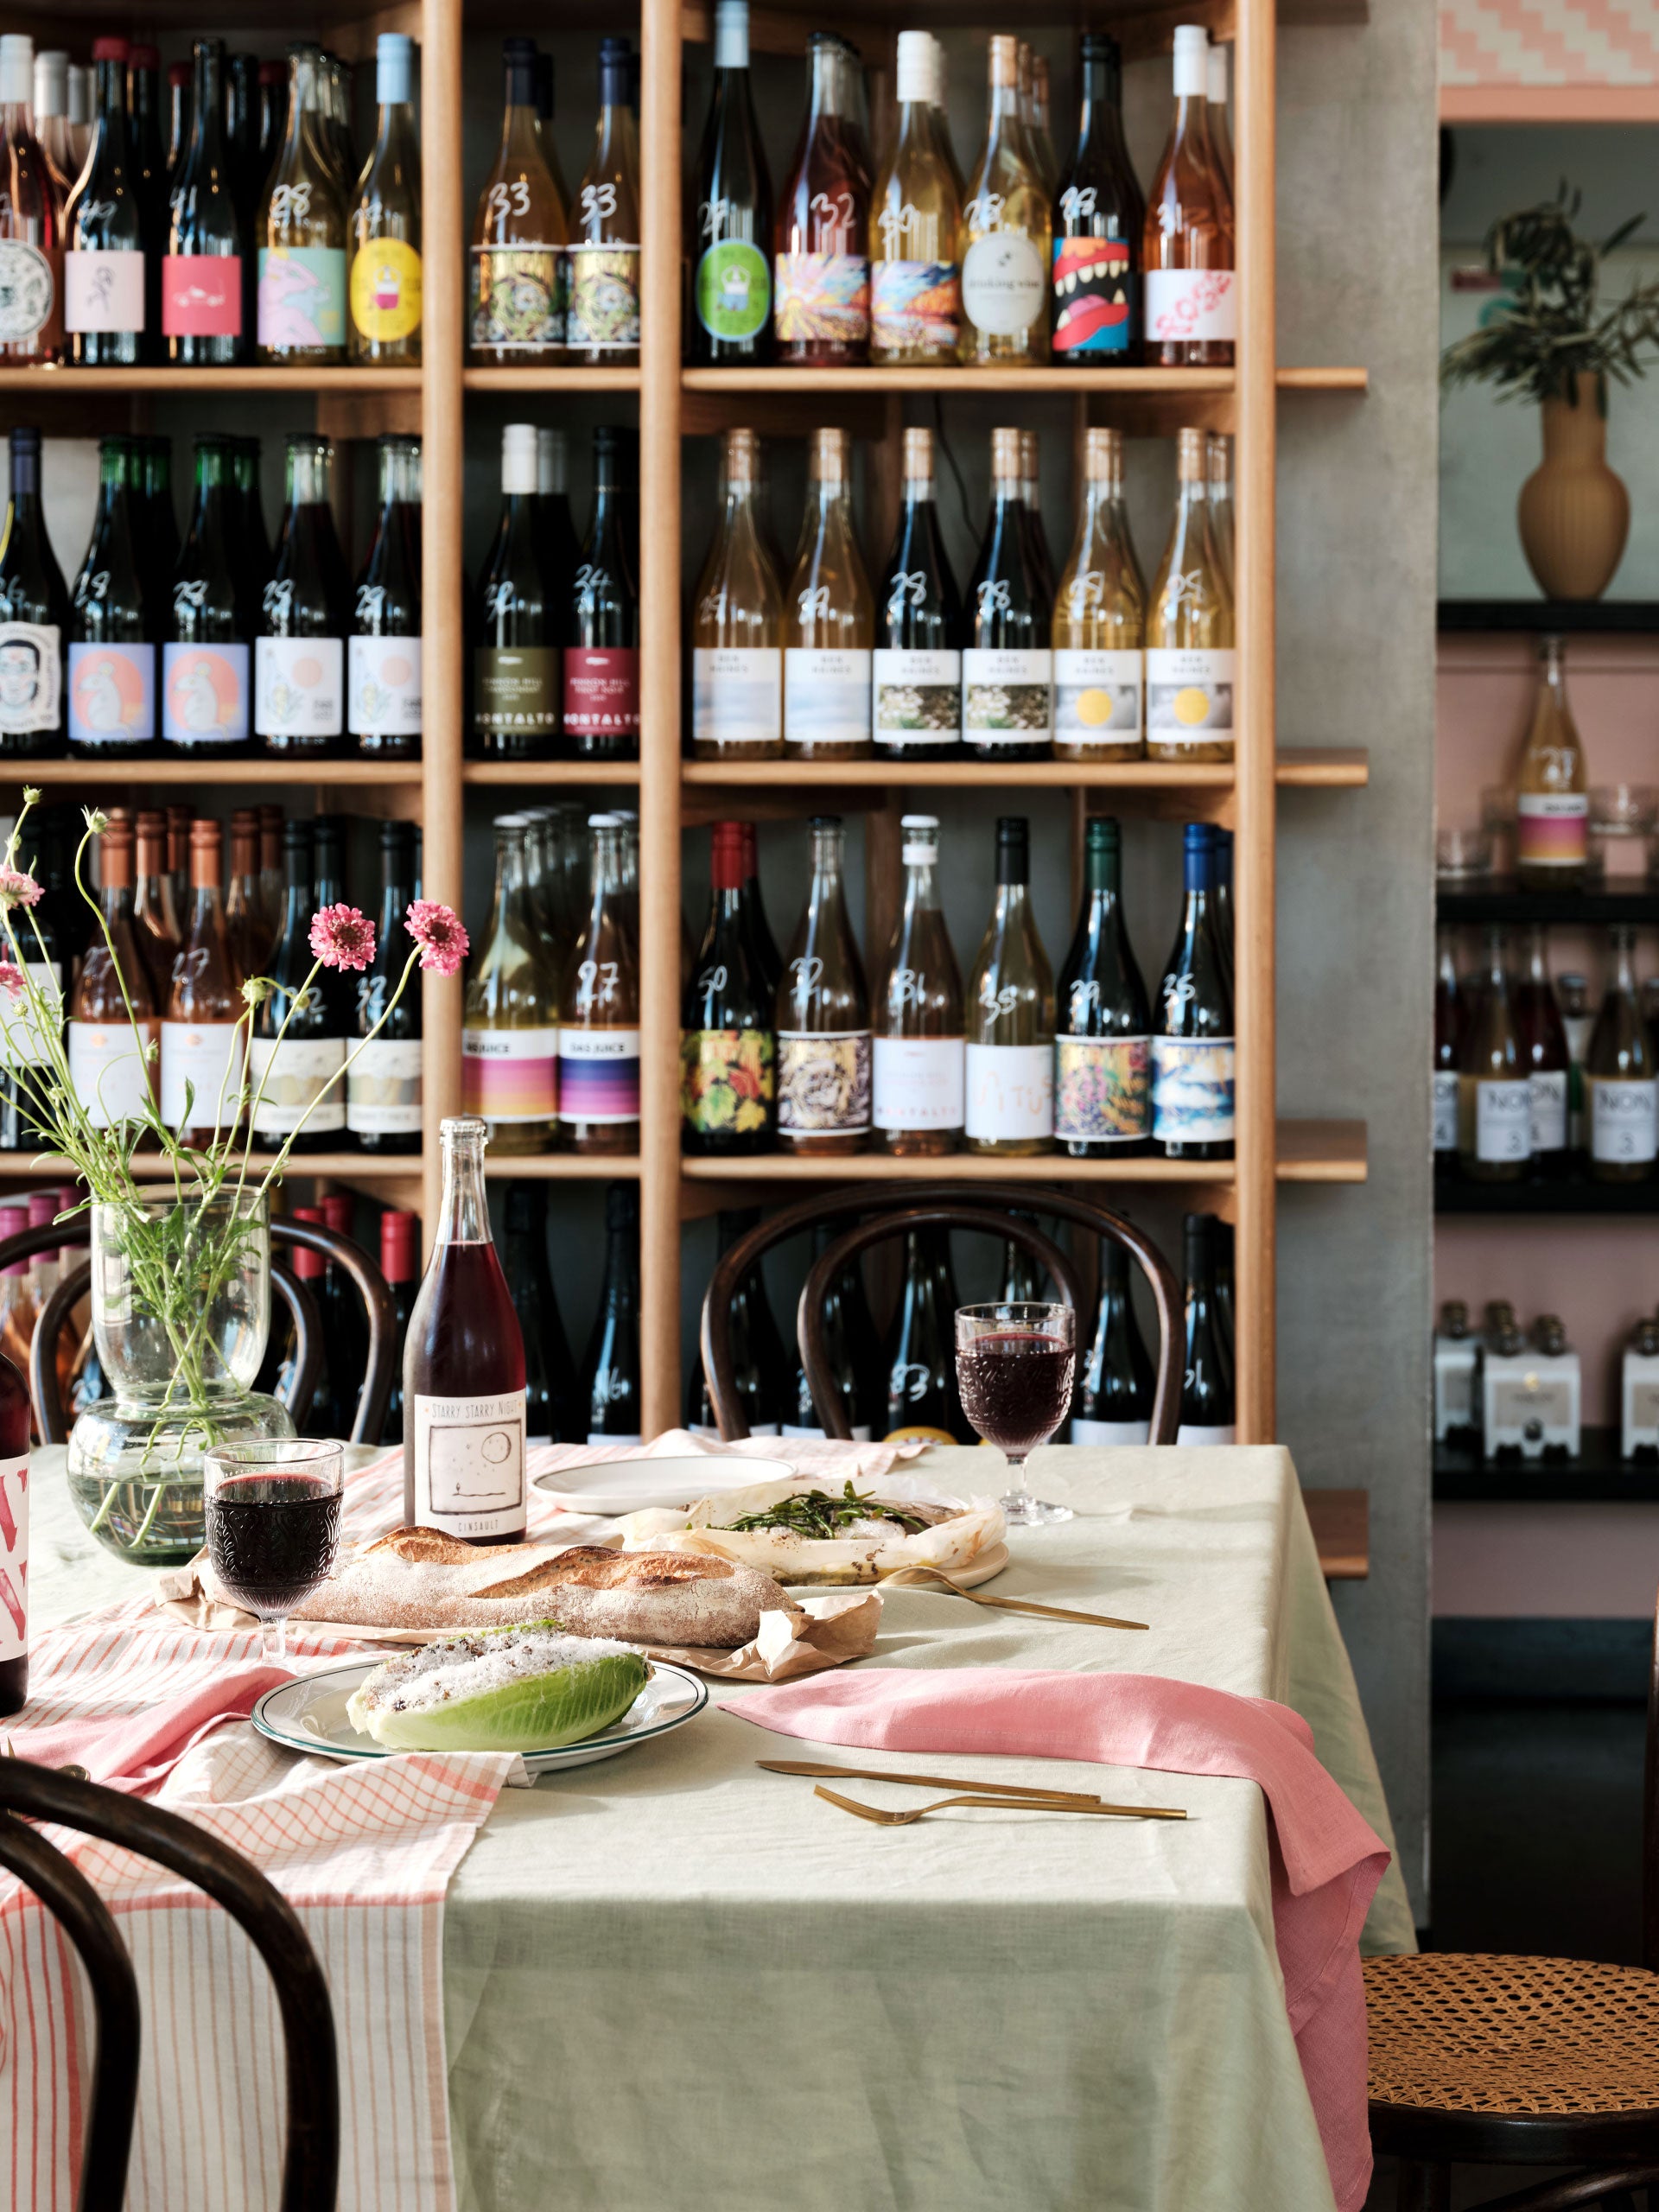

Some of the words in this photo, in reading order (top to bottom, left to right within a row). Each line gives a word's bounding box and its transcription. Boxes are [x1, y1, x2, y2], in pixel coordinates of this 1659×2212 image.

[272, 182, 312, 219] 28
[489, 182, 531, 221] 33
[580, 183, 617, 225] 33
[810, 192, 856, 232] 32
[432, 1403, 461, 1419] STARRY
[466, 1403, 494, 1419] STARRY
[458, 1520, 499, 1532] CINSAULT
